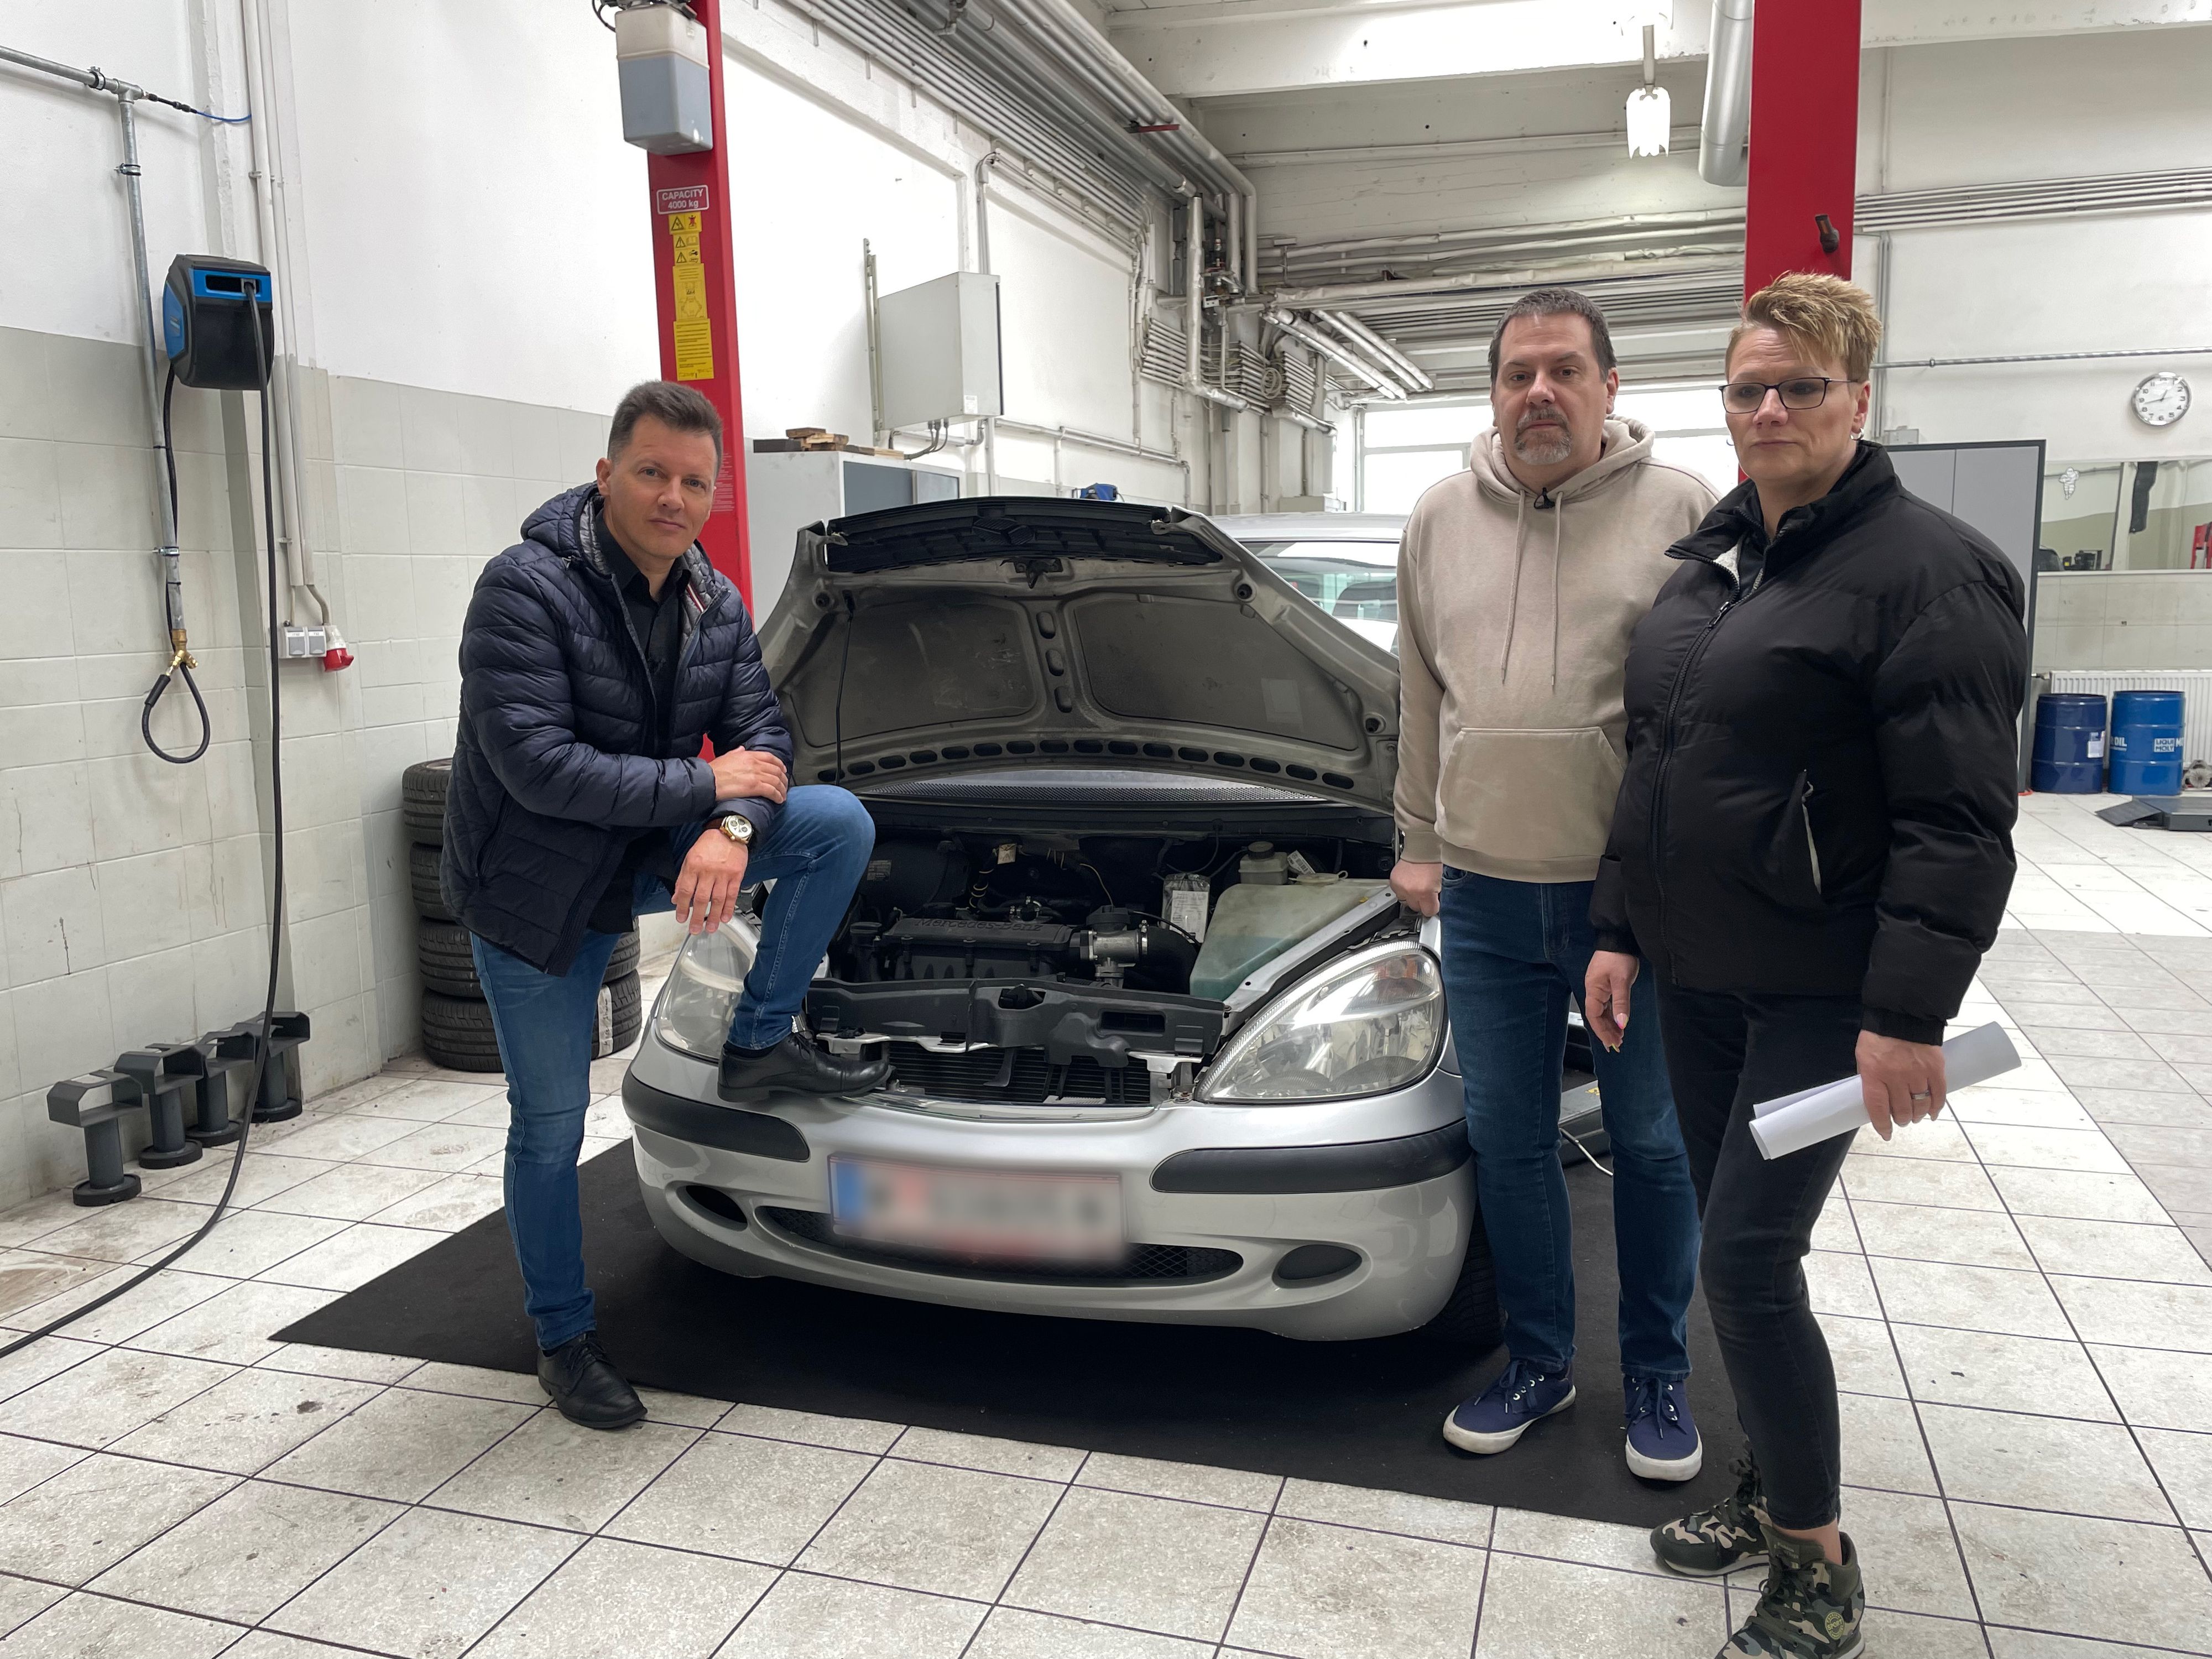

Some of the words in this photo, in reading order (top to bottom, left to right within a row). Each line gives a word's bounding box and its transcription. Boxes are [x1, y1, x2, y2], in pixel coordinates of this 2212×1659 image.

[662, 189, 703, 200] CAPACITY
[668, 200, 686, 209] 4000
[688, 200, 698, 208] kg
[2114, 737, 2127, 747] OIL
[915, 918, 1044, 931] Mercedes-Benz
[1827, 1619, 1842, 1631] SPORT
